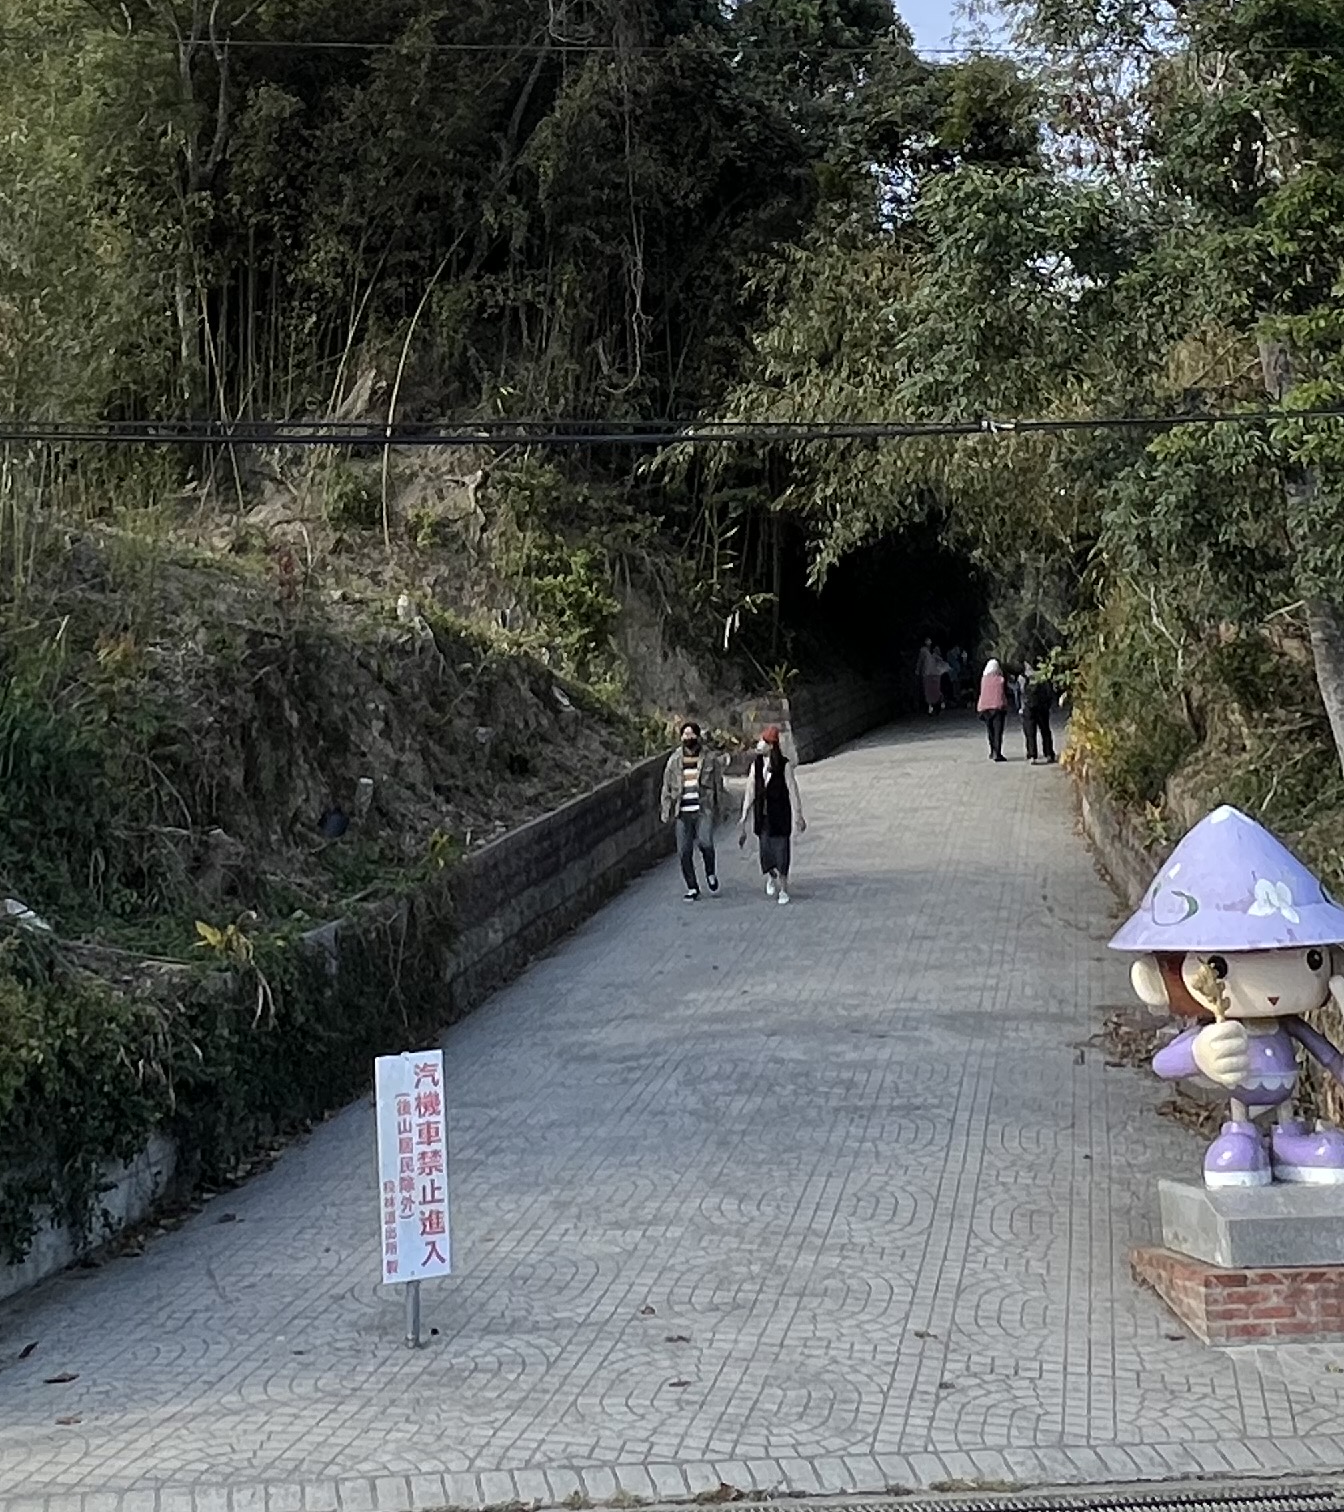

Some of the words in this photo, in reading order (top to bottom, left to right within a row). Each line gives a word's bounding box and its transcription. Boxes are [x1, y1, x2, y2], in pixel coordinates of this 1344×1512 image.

[414, 1062, 446, 1268] 汽機車禁止進入
